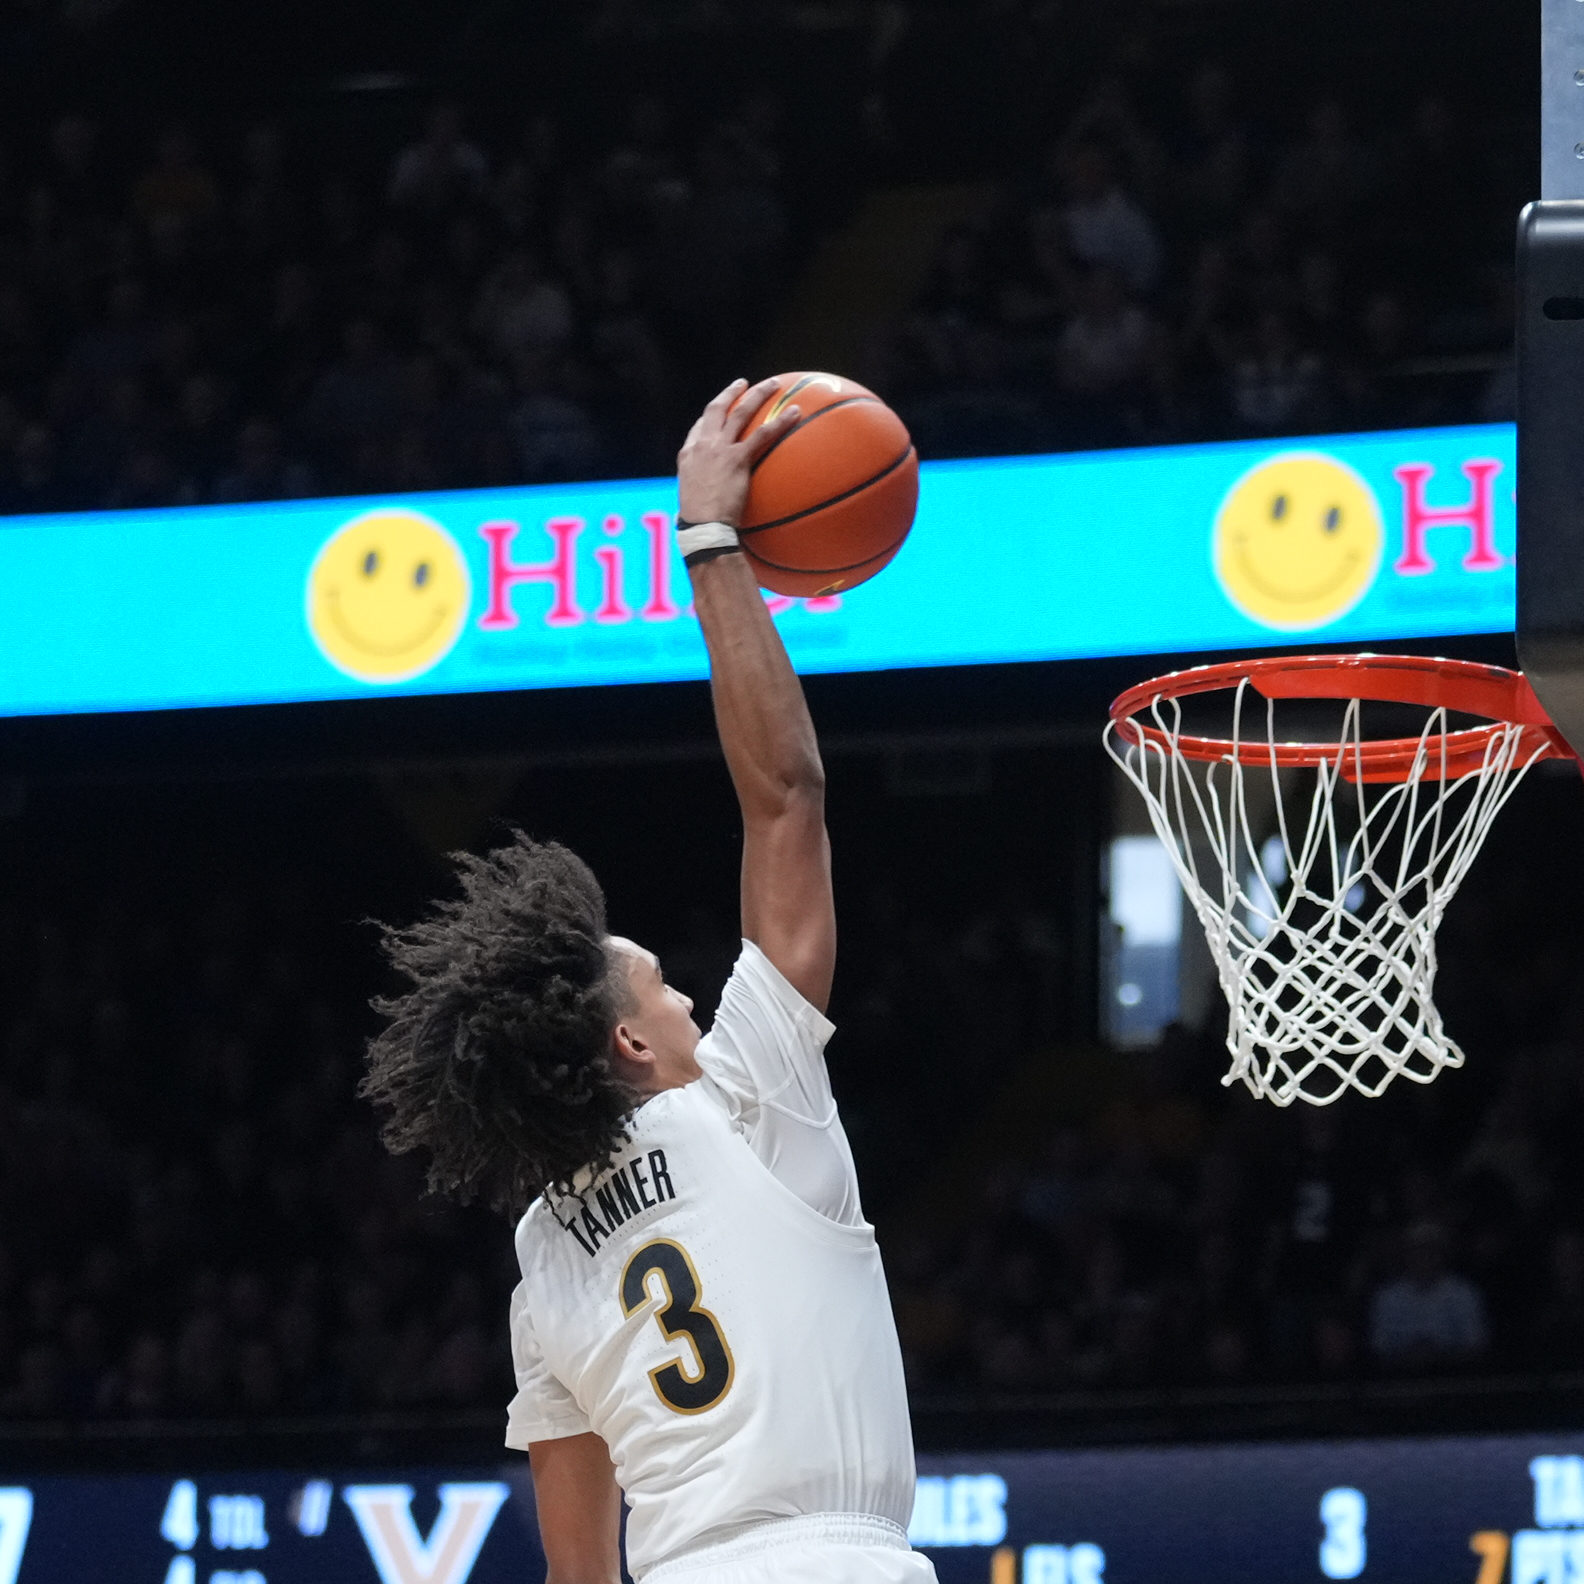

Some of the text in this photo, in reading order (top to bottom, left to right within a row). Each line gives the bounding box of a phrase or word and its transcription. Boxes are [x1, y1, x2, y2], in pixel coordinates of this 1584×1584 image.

[564, 1148, 677, 1258] TANNER
[619, 1238, 735, 1415] 3
[160, 1479, 199, 1550] 4
[907, 1474, 1008, 1547] ILES
[1320, 1488, 1366, 1580] 3
